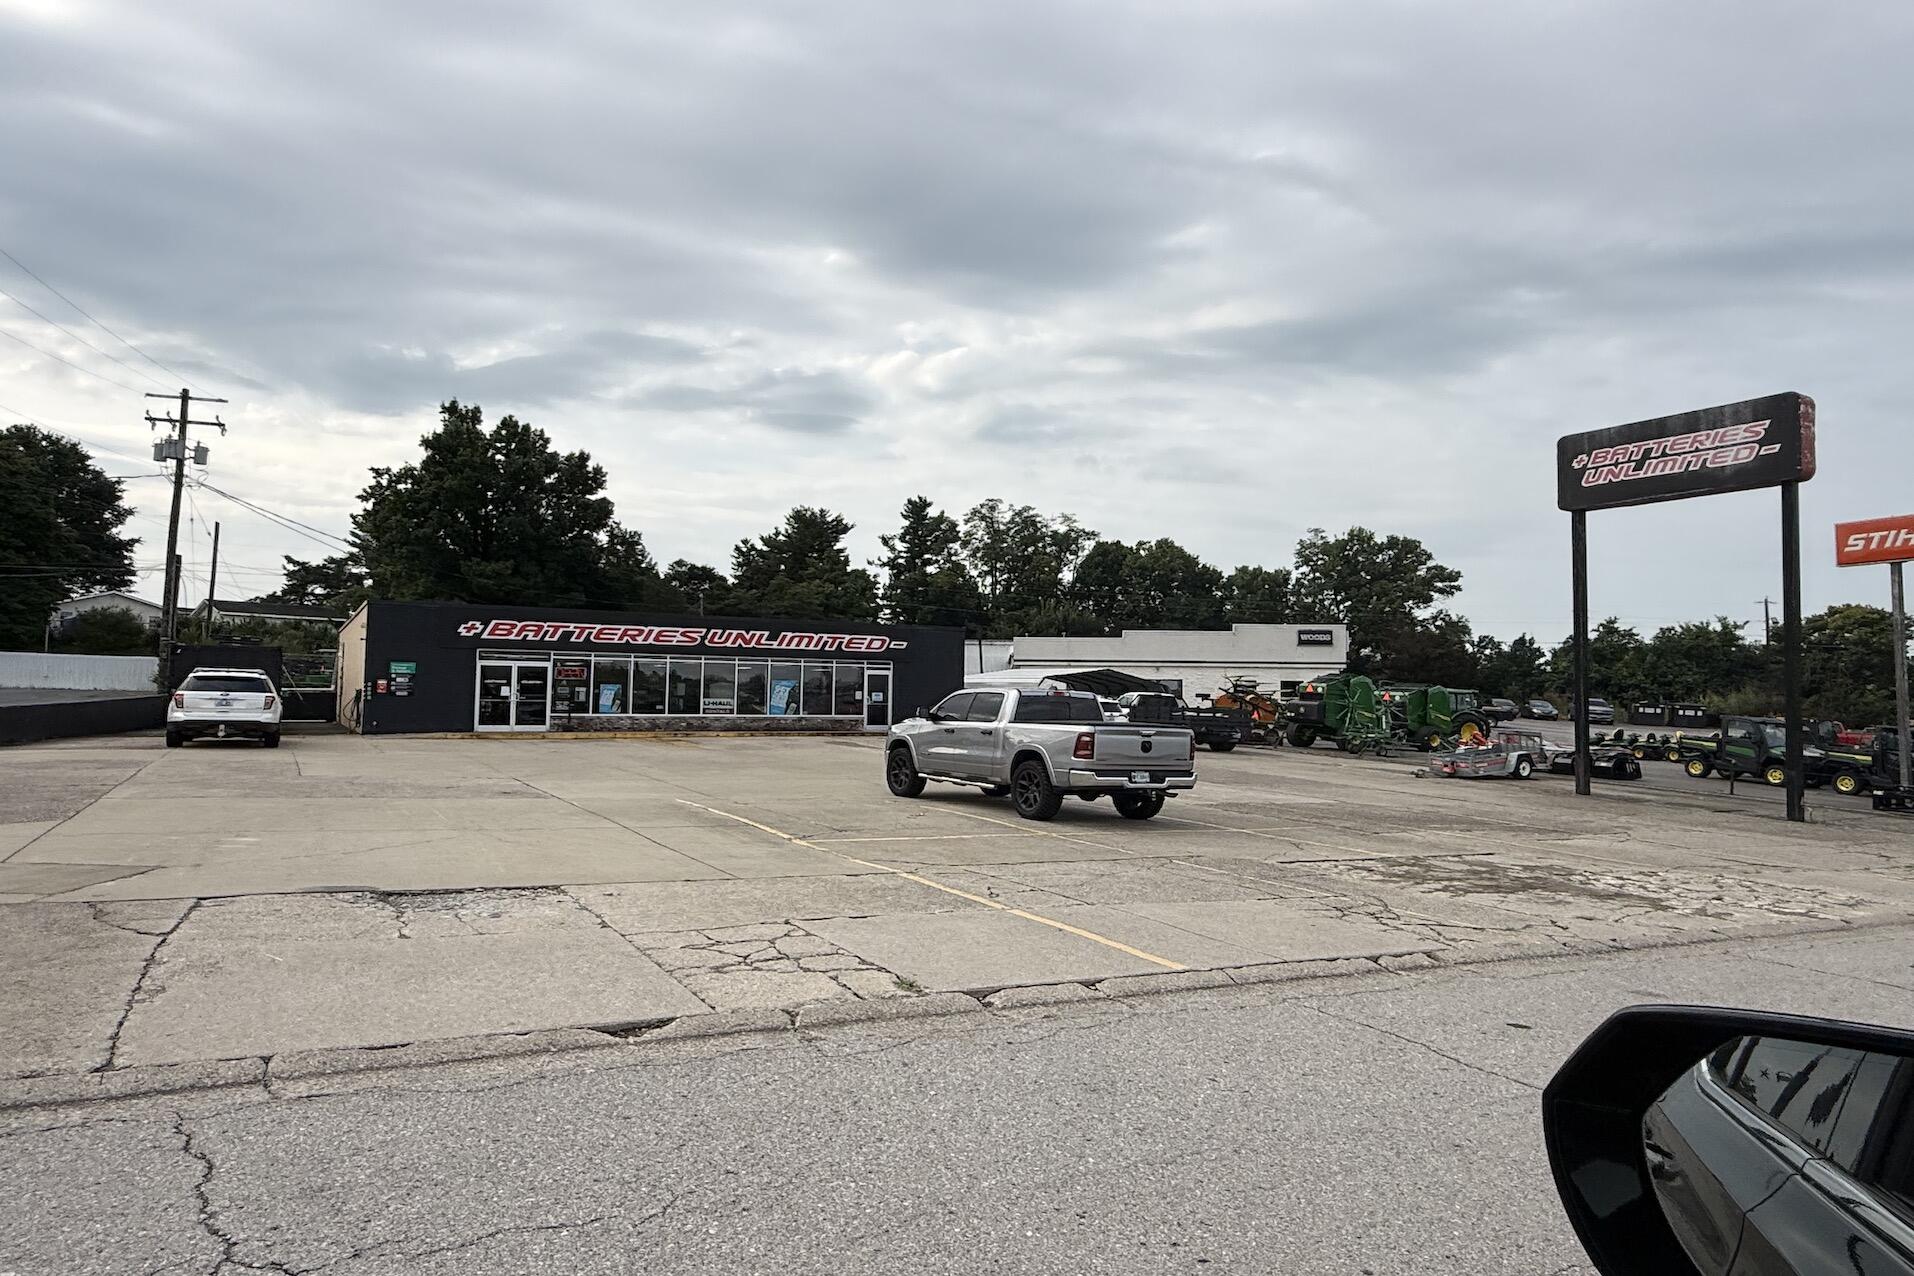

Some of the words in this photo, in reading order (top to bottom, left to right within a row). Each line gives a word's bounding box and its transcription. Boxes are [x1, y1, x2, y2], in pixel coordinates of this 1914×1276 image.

[1587, 420, 1771, 468] BATTERIES
[481, 619, 707, 646] BATTERIES
[1300, 633, 1332, 641] WOODS
